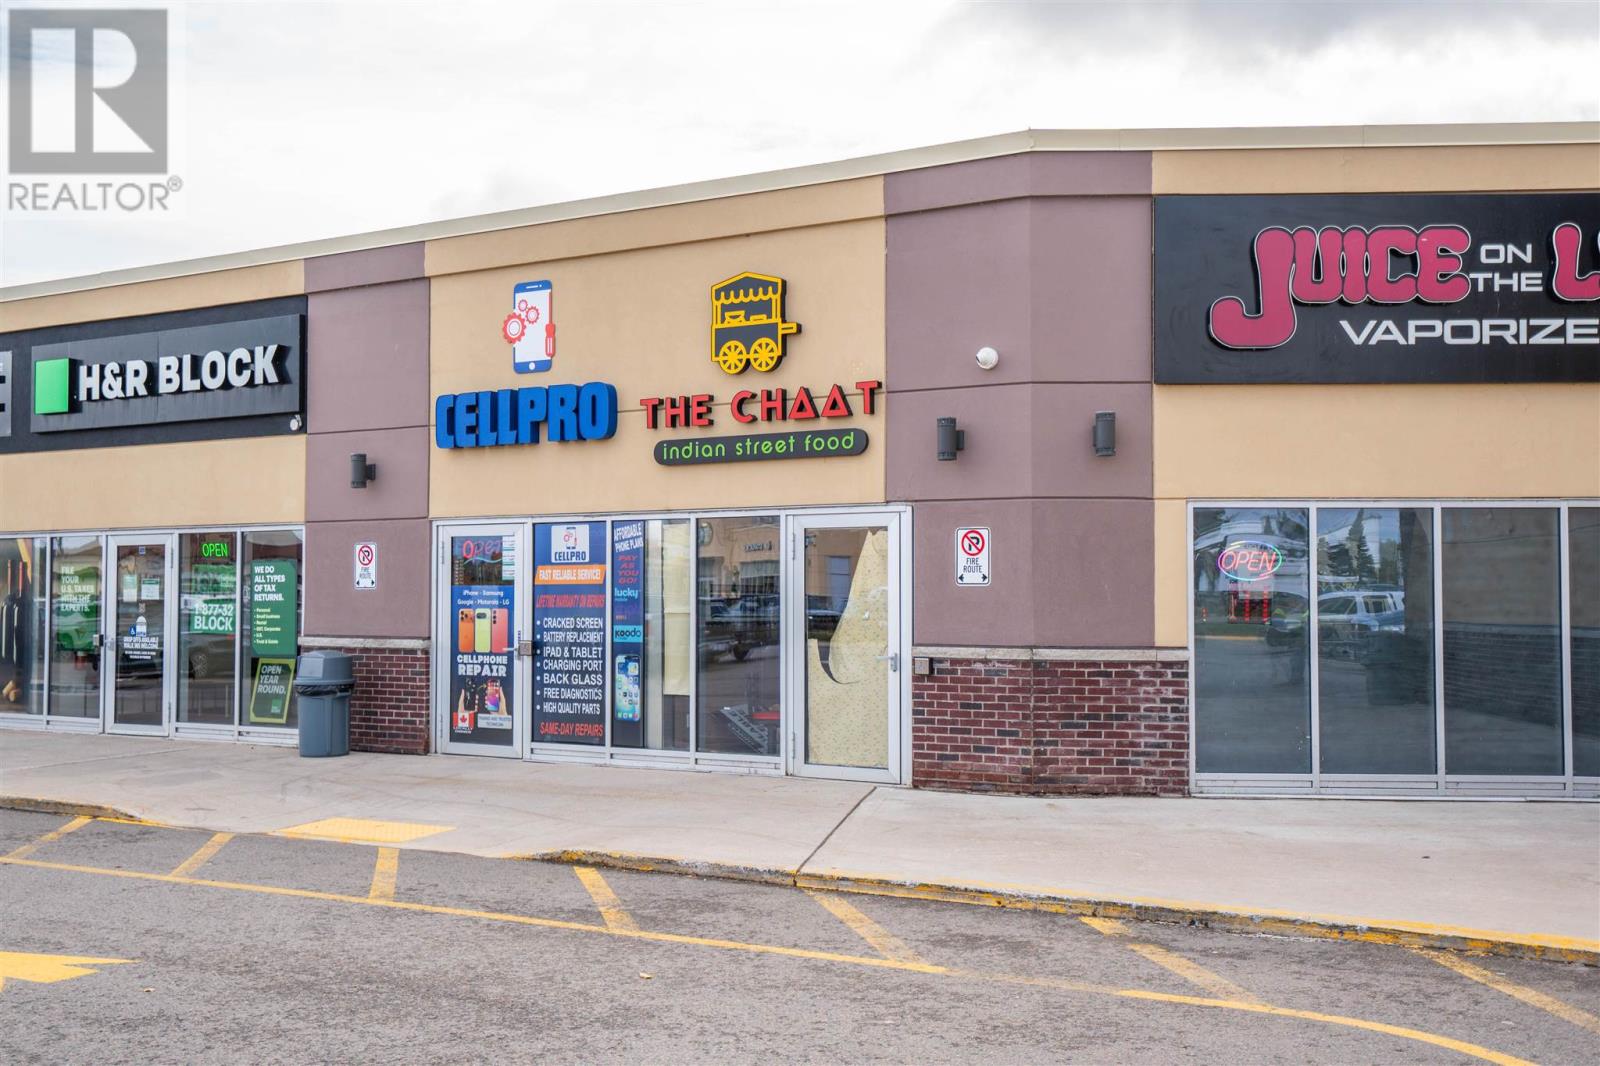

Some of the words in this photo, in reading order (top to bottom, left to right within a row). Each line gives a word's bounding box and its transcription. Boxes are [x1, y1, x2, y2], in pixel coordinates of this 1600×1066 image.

[1480, 244, 1532, 263] ON
[1552, 222, 1600, 301] L
[1209, 224, 1472, 349] JUICE
[1469, 272, 1543, 292] THE
[1339, 319, 1600, 345] VAPORIZE
[78, 359, 149, 401] H&R
[158, 344, 283, 394] BLOCK
[639, 393, 715, 430] THE
[730, 380, 883, 424] CHAAT
[435, 381, 618, 449] CELLPRO
[662, 439, 727, 461] indian
[735, 435, 796, 457] street
[804, 431, 856, 452] food
[614, 523, 643, 541] AFFORDABLE
[202, 543, 228, 557] OPEN
[614, 540, 630, 553] PHONE
[630, 537, 644, 550] PLANS
[554, 551, 587, 561] CELLPRO
[1221, 551, 1277, 571] OPEN
[254, 566, 265, 574] WE
[265, 566, 274, 574] DO
[539, 569, 552, 580] FAST
[552, 569, 577, 580] RELIABLE
[963, 565, 983, 573] ROUTE
[61, 575, 80, 584] YOUR
[254, 575, 265, 583] ALL
[266, 575, 286, 583] TYPES
[254, 584, 263, 592] OF
[264, 584, 276, 592] TAX
[614, 588, 639, 599] lucky
[254, 593, 284, 602] RETURNS.
[194, 603, 234, 616] 1-877-32
[194, 616, 233, 631] BLOCK
[543, 617, 575, 629] CRACKED
[576, 618, 603, 629] SCREEN
[543, 631, 565, 642] BATTERY
[566, 632, 603, 643] REPLACEMENT
[614, 628, 641, 638] koodo
[543, 646, 562, 658] IPAD
[563, 647, 570, 657] &
[571, 647, 603, 658] TABLET
[456, 655, 508, 664] CELLPHONE
[543, 659, 581, 671] CHARGING
[582, 660, 603, 671] PORT
[261, 665, 282, 674] OPEN
[458, 664, 507, 677] REPAIR
[260, 674, 279, 684] YEAR
[543, 673, 570, 684] BACK
[571, 674, 603, 686] GLASS
[257, 684, 287, 695] ROUND.
[543, 687, 560, 699] FREE
[560, 688, 603, 700] DIAGNOSTICS
[543, 701, 557, 713] HIGH
[557, 702, 581, 714] QUALITY
[581, 704, 601, 715] PARTS
[539, 722, 574, 735] SAME-DAY
[574, 723, 604, 737] REPAIRS
